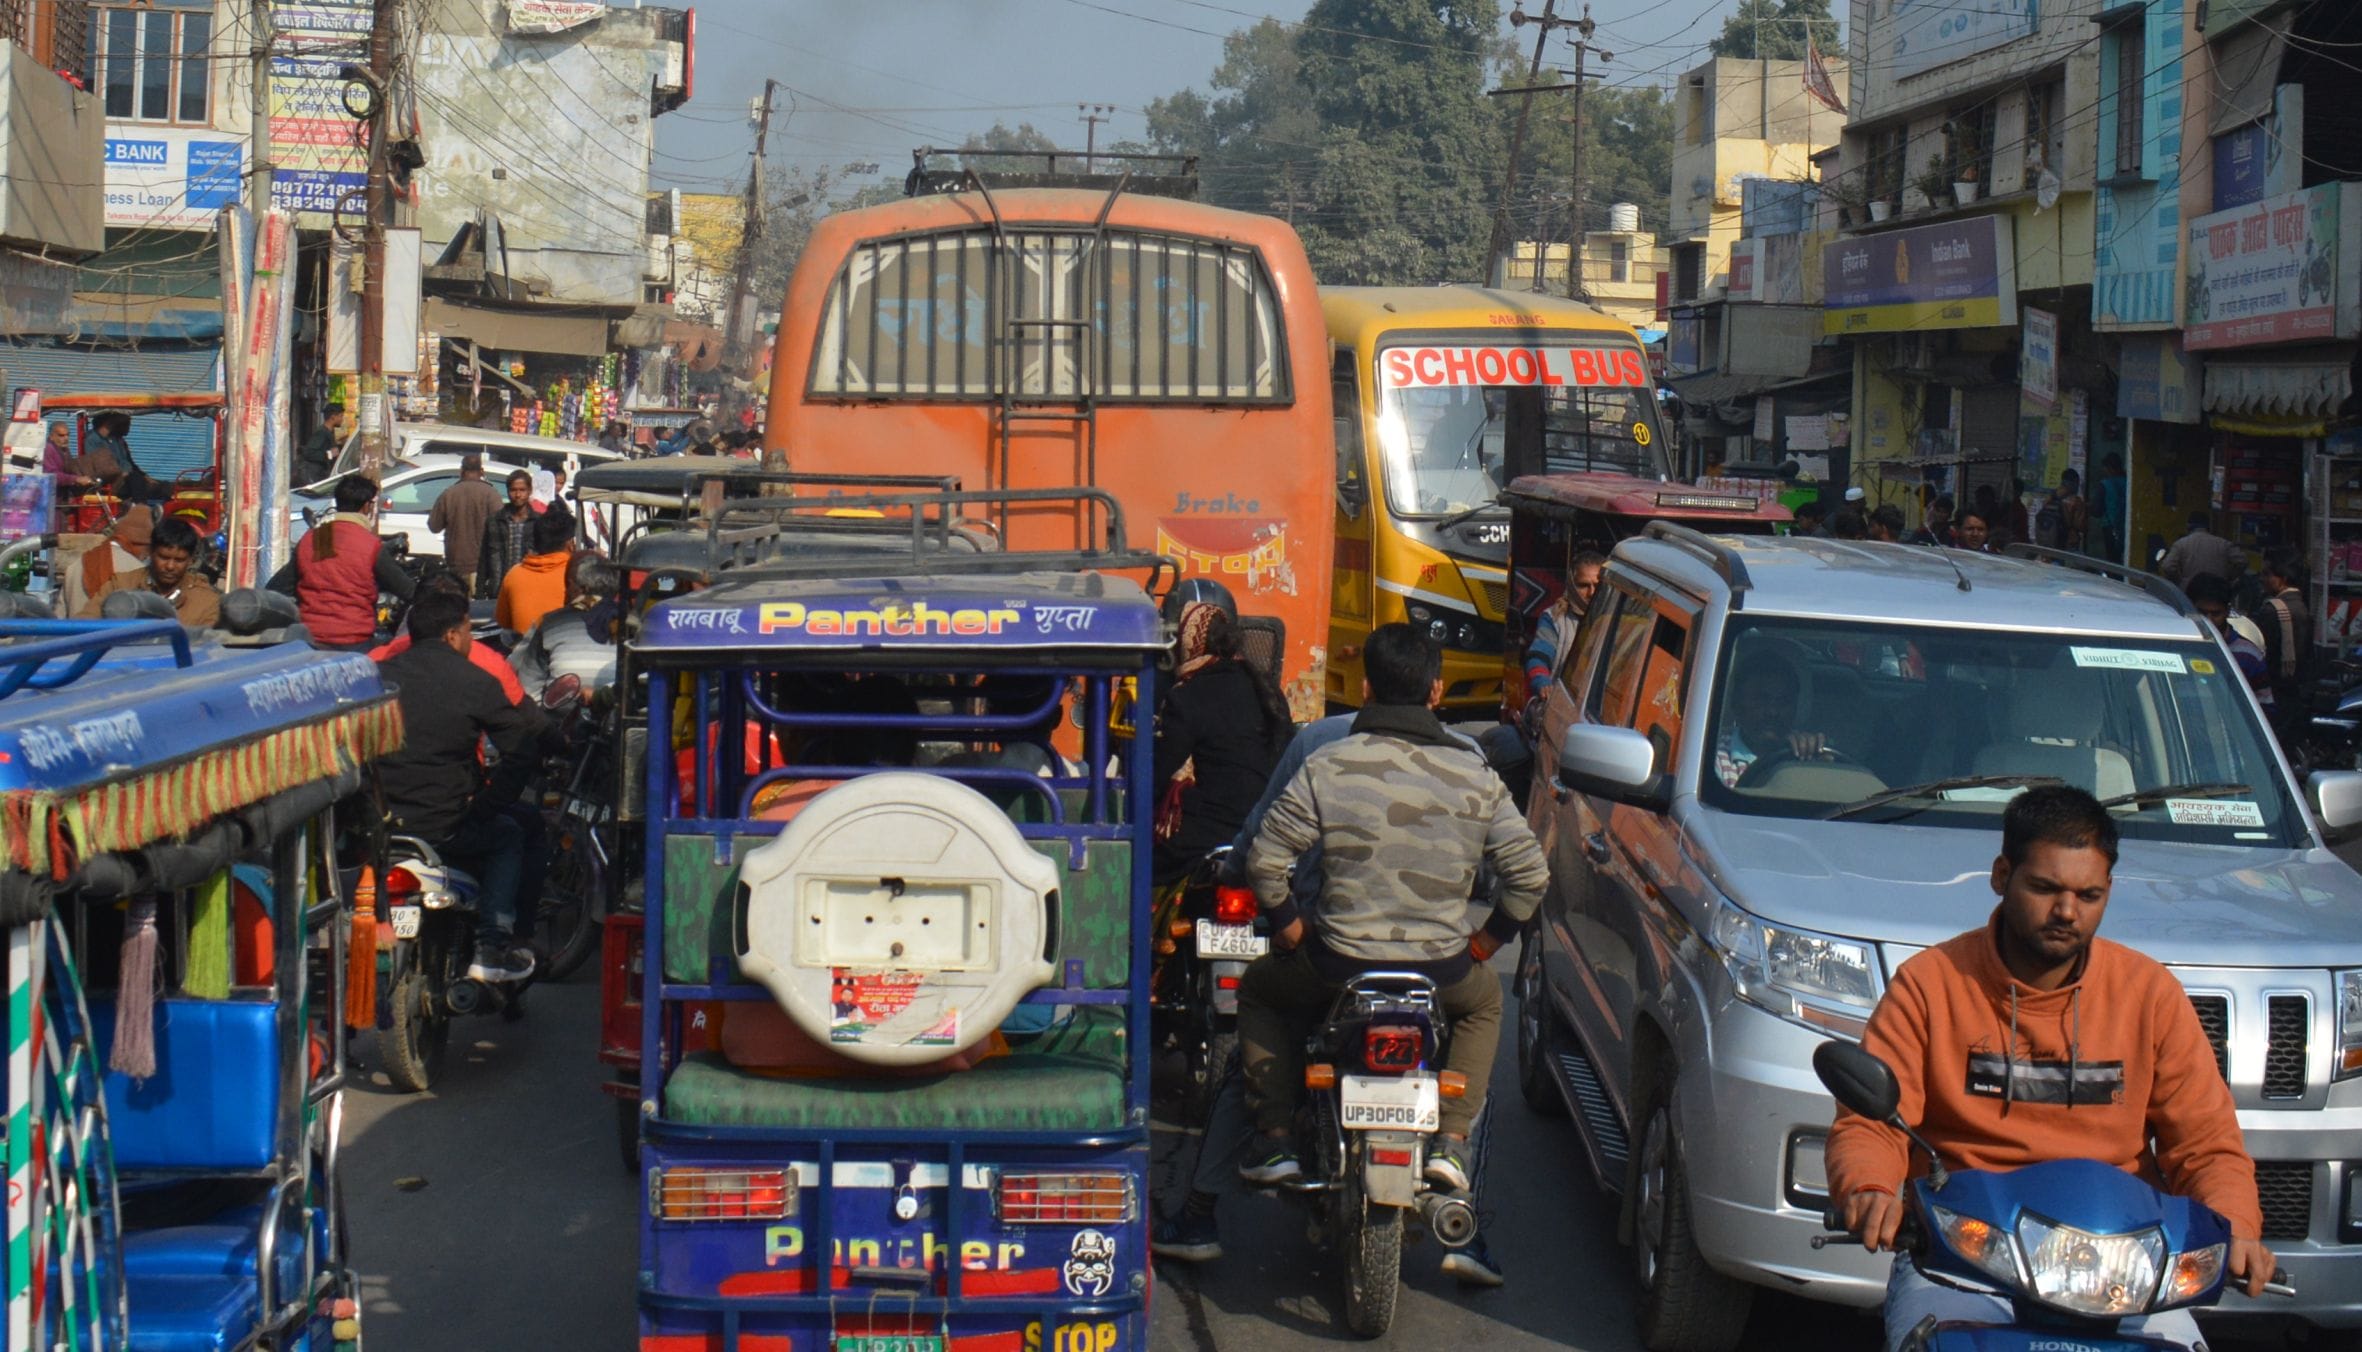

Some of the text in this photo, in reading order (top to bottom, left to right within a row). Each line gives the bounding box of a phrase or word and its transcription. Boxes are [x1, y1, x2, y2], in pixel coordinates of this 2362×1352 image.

[115, 143, 164, 161] BANK
[139, 193, 174, 206] Loan
[1931, 238, 1973, 263] Indian Bank
[2207, 220, 2238, 261] पाठक
[1489, 314, 1546, 326] SARANG
[1386, 347, 1645, 387] SCHOOL BUS
[1173, 491, 1261, 514] Brake
[1156, 527, 1286, 574] STOP
[668, 608, 748, 635] रामबाबू
[758, 602, 1020, 635] Panther
[1033, 606, 1098, 634] गुप्ता
[2082, 654, 2120, 664] VIDHUT
[2170, 801, 2226, 811] आवश्यक
[1210, 938, 1258, 954] F4604
